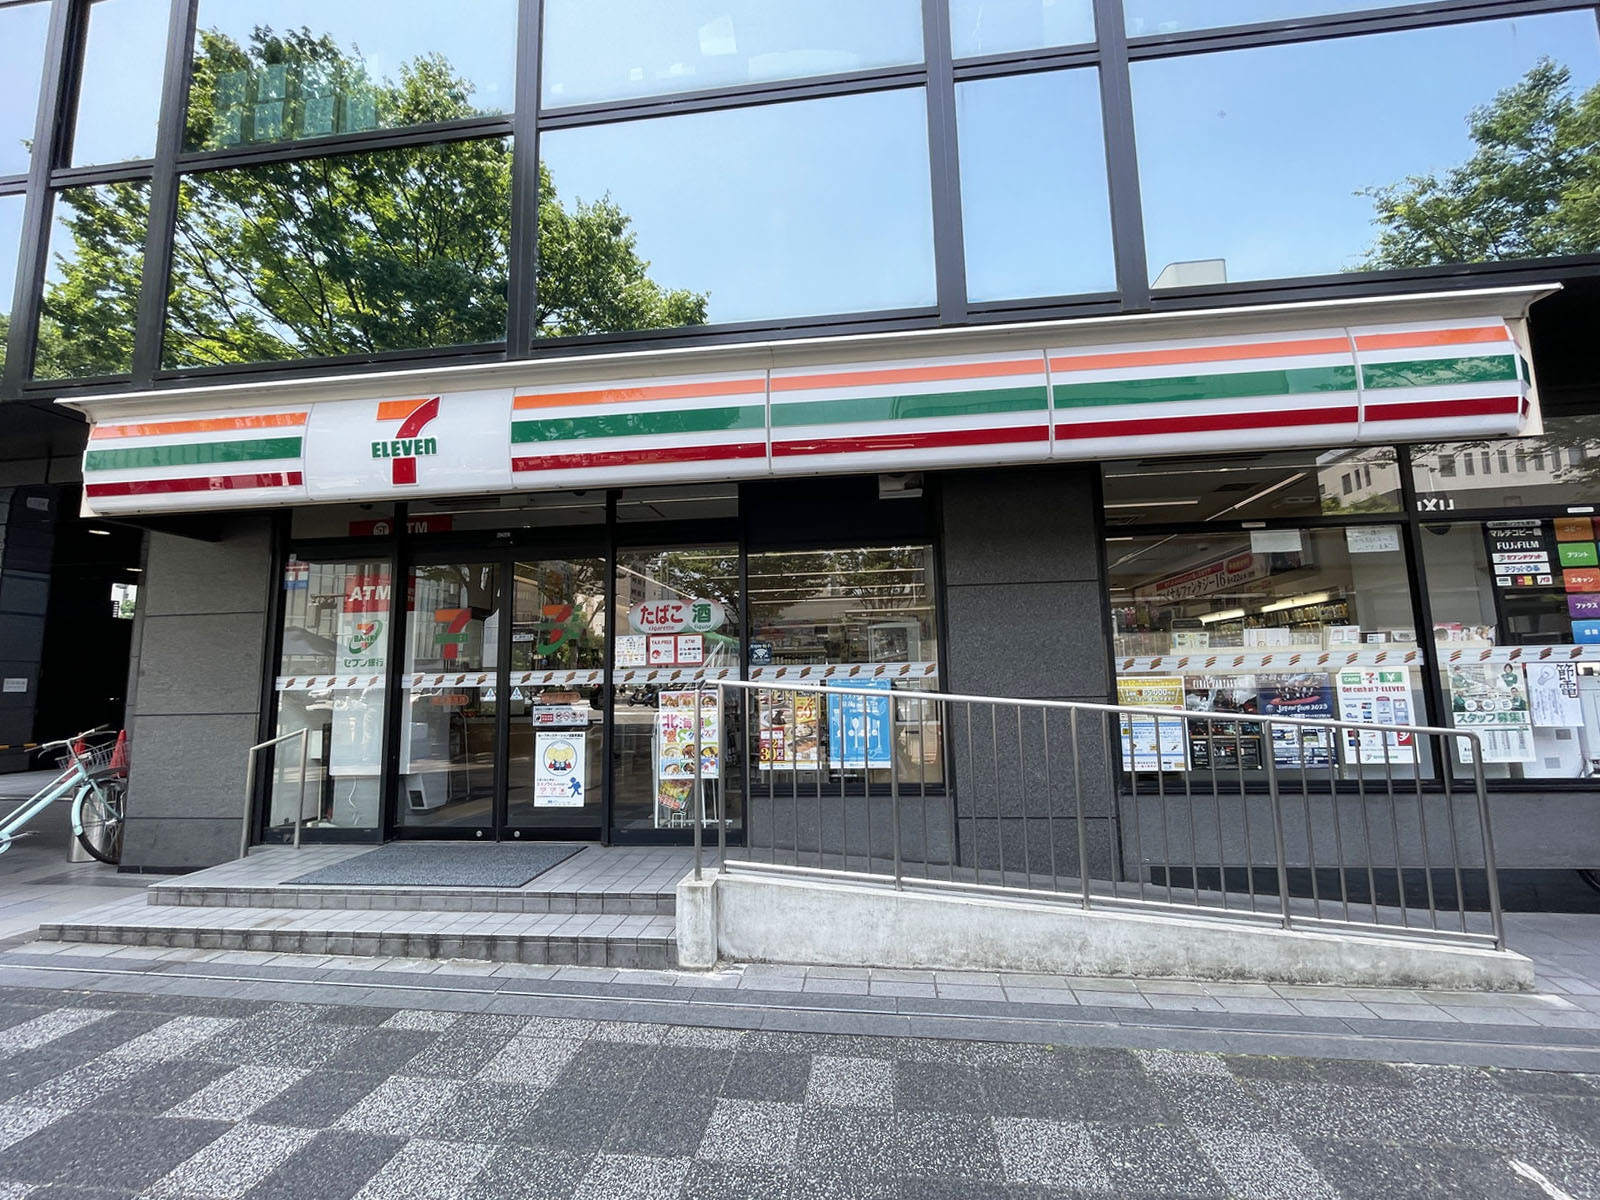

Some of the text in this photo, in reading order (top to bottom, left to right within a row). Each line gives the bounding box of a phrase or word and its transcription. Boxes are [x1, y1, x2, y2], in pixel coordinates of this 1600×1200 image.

[405, 521, 428, 534] TM
[1489, 528, 1542, 537] マルチコピー機
[1566, 551, 1589, 559] プリント
[349, 585, 391, 602] ATM
[640, 603, 712, 625] たばこ 酒
[343, 657, 384, 668] セブン銀行
[1556, 663, 1579, 699] 節電
